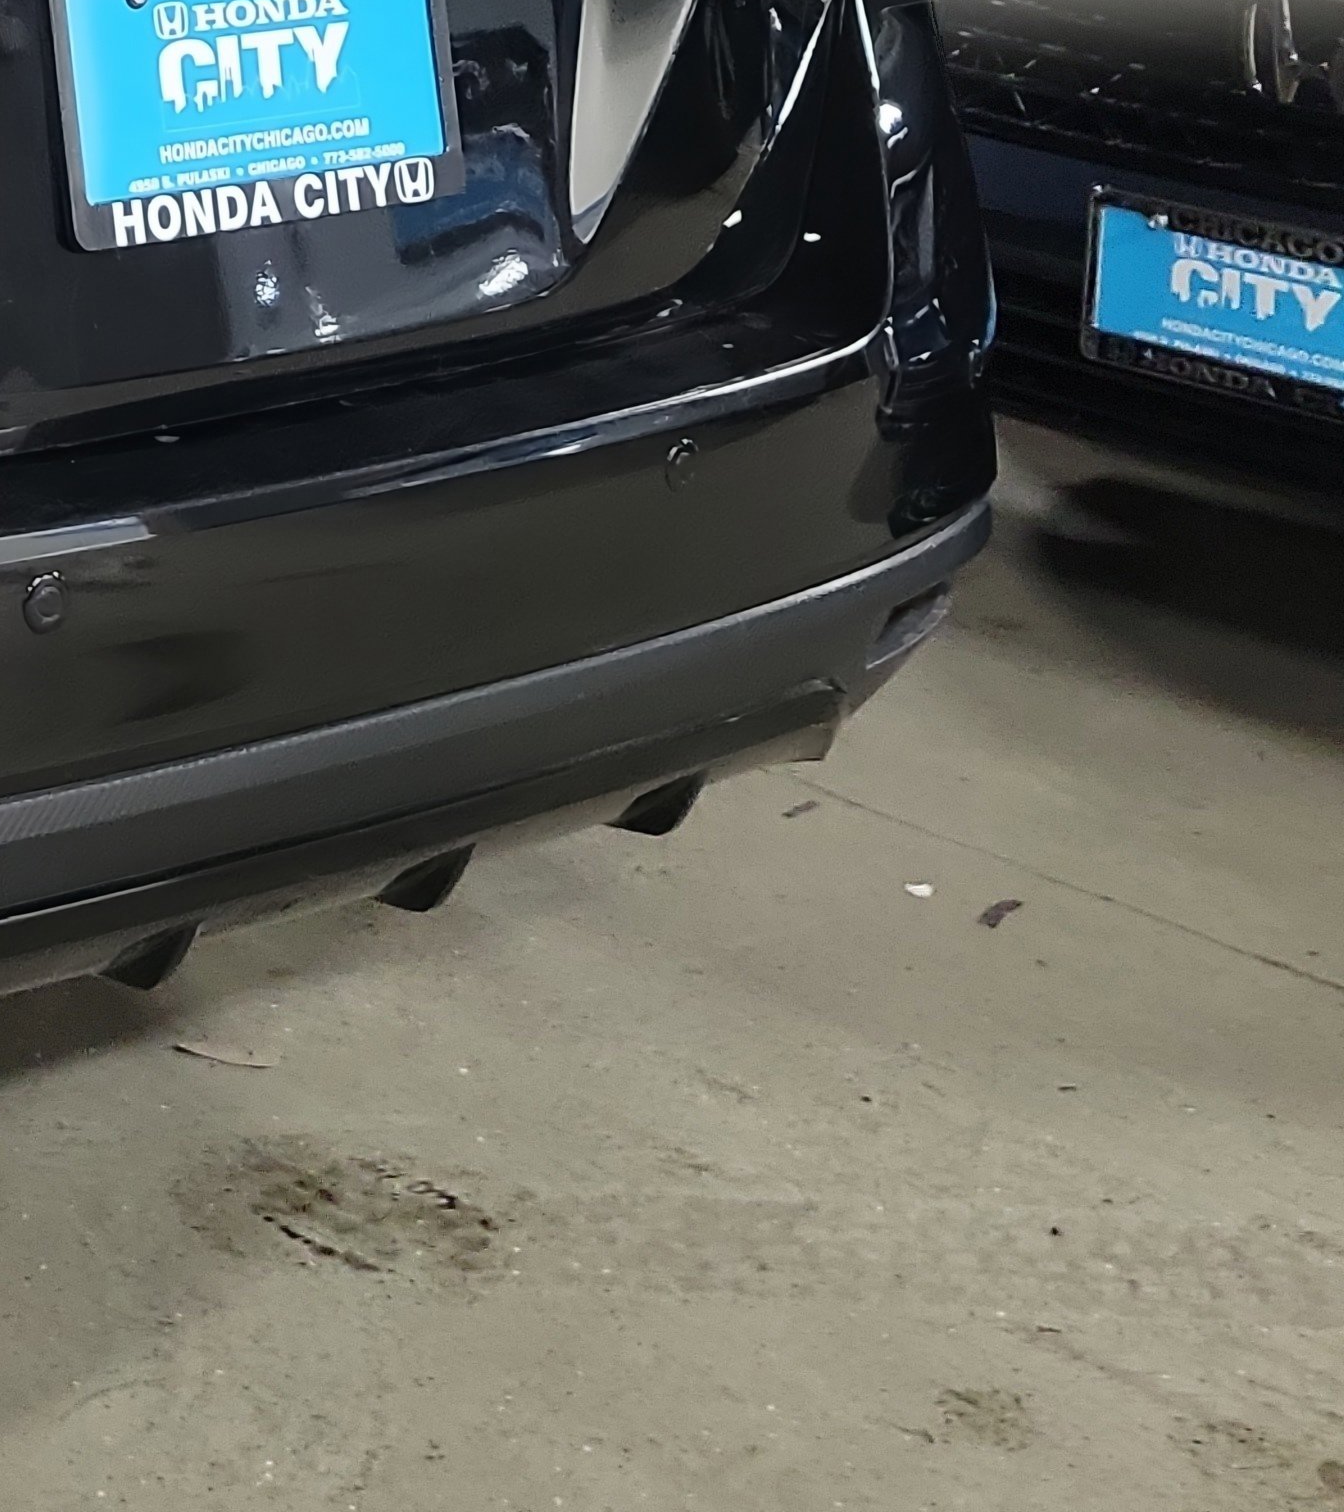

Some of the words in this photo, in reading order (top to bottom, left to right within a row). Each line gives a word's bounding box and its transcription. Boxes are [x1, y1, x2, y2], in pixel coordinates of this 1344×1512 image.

[157, 20, 351, 113] CITY
[159, 117, 370, 164] HONDACITYCHICAGO.COM
[247, 155, 306, 176] CHICAGO
[111, 180, 283, 248] HONDA
[293, 162, 392, 220] CITY
[1170, 257, 1342, 332] CITY
[1207, 239, 1344, 288] HONDA
